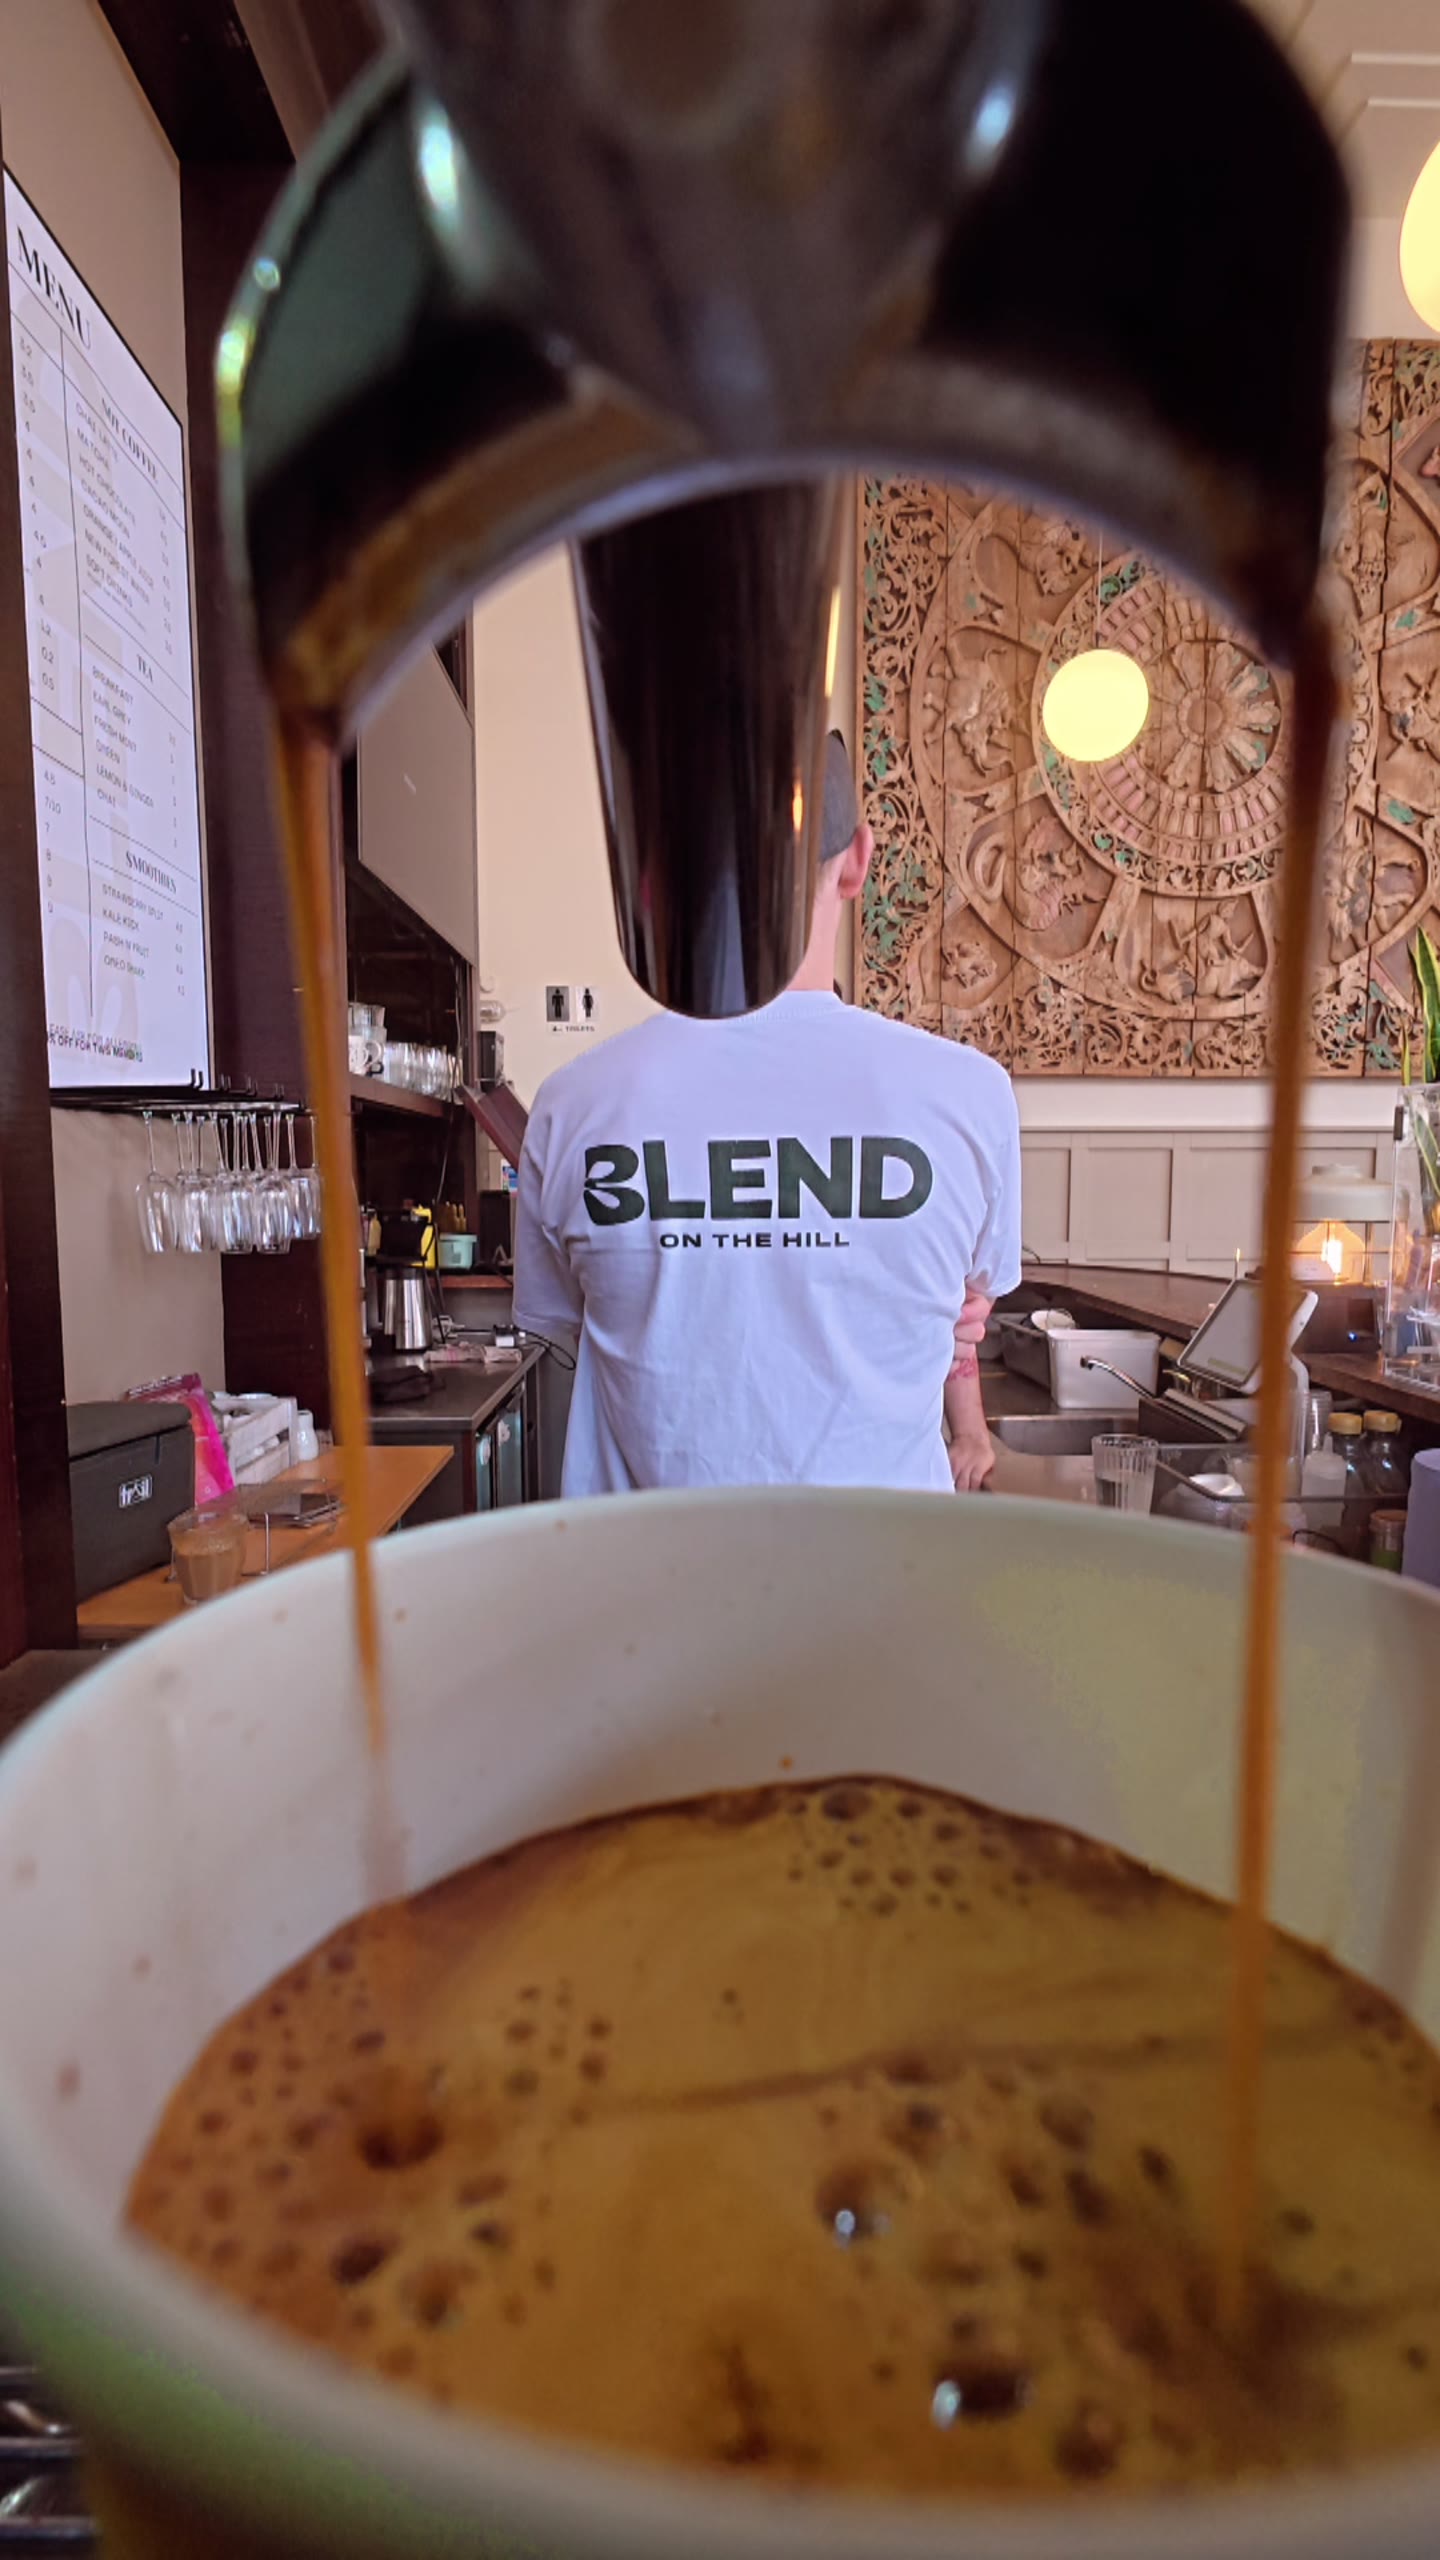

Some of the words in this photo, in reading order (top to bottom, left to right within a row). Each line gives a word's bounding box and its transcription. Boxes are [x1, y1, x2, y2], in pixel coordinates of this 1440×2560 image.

[17, 226, 91, 351] MENU
[77, 425, 108, 469] MATCHA
[121, 426, 156, 481] COFFEE
[136, 654, 152, 681] TEA
[96, 762, 120, 786] LEMON
[126, 850, 176, 892] SMOOTHIES
[103, 908, 120, 922] KALE
[75, 1039, 90, 1050] FOR
[583, 1136, 933, 1226] BLEND
[659, 1234, 701, 1248] ON
[712, 1234, 772, 1248] THE
[782, 1234, 850, 1248] HILL
